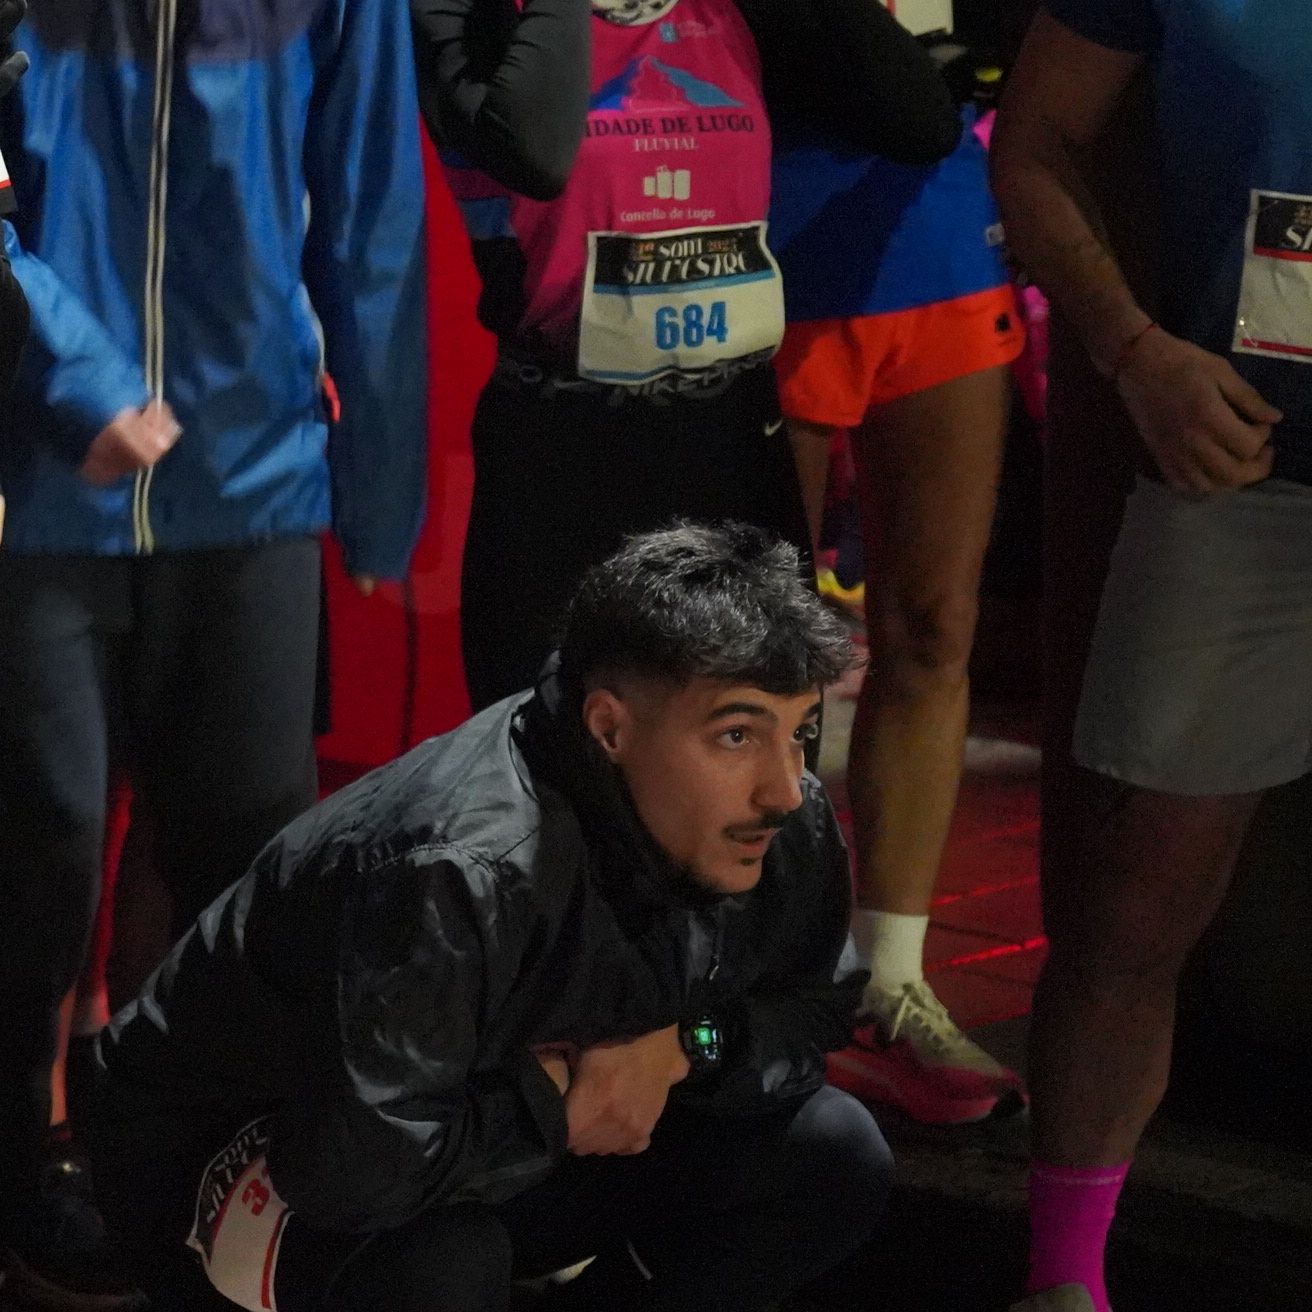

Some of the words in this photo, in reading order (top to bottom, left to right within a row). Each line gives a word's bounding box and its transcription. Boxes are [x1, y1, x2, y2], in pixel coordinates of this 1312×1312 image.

[661, 116, 691, 134] DE
[697, 114, 754, 133] LUGO
[633, 137, 700, 152] FLUVIAL
[620, 208, 667, 222] Concello
[670, 208, 684, 219] de
[687, 207, 716, 222] Lugo
[655, 300, 729, 351] 684
